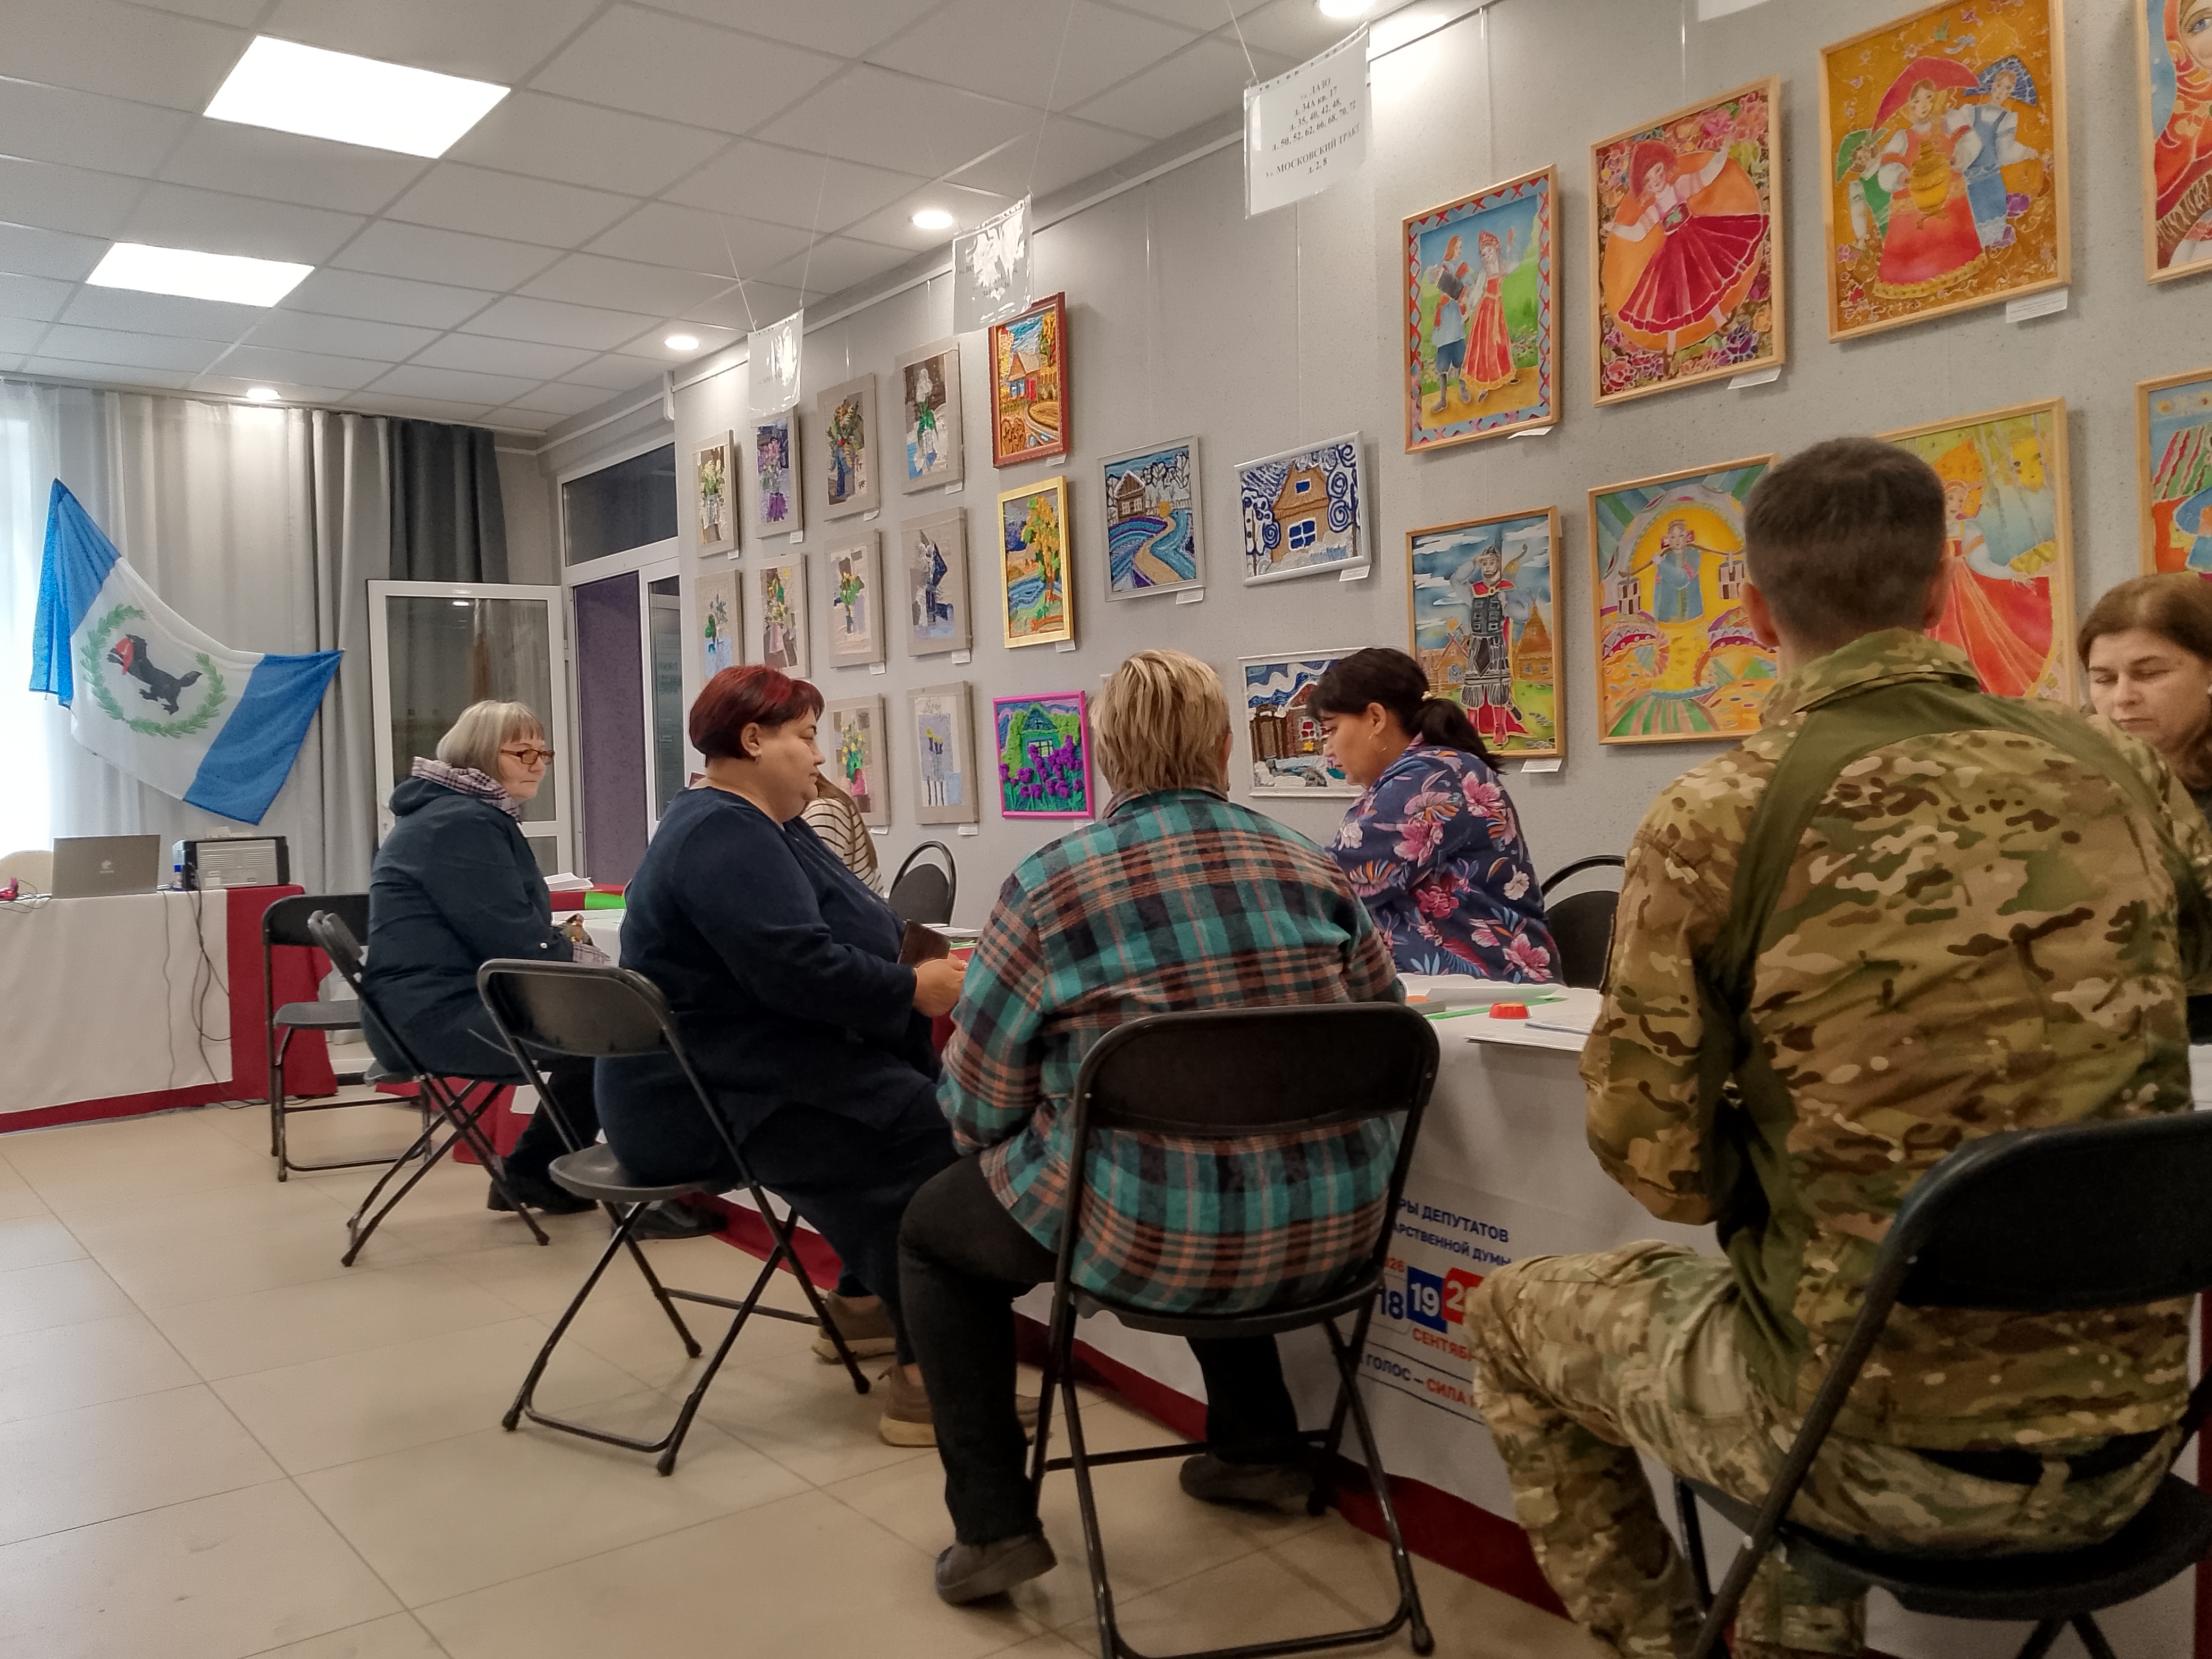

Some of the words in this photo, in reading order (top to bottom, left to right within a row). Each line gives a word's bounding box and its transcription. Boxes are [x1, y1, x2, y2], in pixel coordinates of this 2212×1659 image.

[1309, 77, 1330, 96] ЛАЗО
[1318, 94, 1328, 105] кв.
[1330, 86, 1338, 97] 17
[1271, 143, 1278, 153] д.
[1281, 137, 1291, 147] 50,
[1293, 131, 1303, 143] 52,
[1305, 125, 1315, 136] 62,
[1316, 120, 1326, 131] 66,
[1339, 107, 1348, 117] 70,
[1349, 99, 1355, 111] 72
[1298, 115, 1308, 127] 35,
[1310, 111, 1319, 121] 40,
[1321, 104, 1331, 115] 42,
[1276, 137, 1337, 174] МОСКОВСКИЙ
[1339, 122, 1360, 145] ТРАКТ
[1308, 166, 1314, 175] д.
[1399, 1199, 1418, 1216] РЫ
[1422, 1205, 1509, 1243] ДЕПУТАТОВ
[1392, 1222, 1470, 1256] АРСТВЕННОЙ
[1410, 1282, 1440, 1317] 19
[1446, 1280, 1478, 1312] 2
[1365, 1354, 1411, 1381] ГОЛОС
[1426, 1378, 1466, 1405] СИЛА
